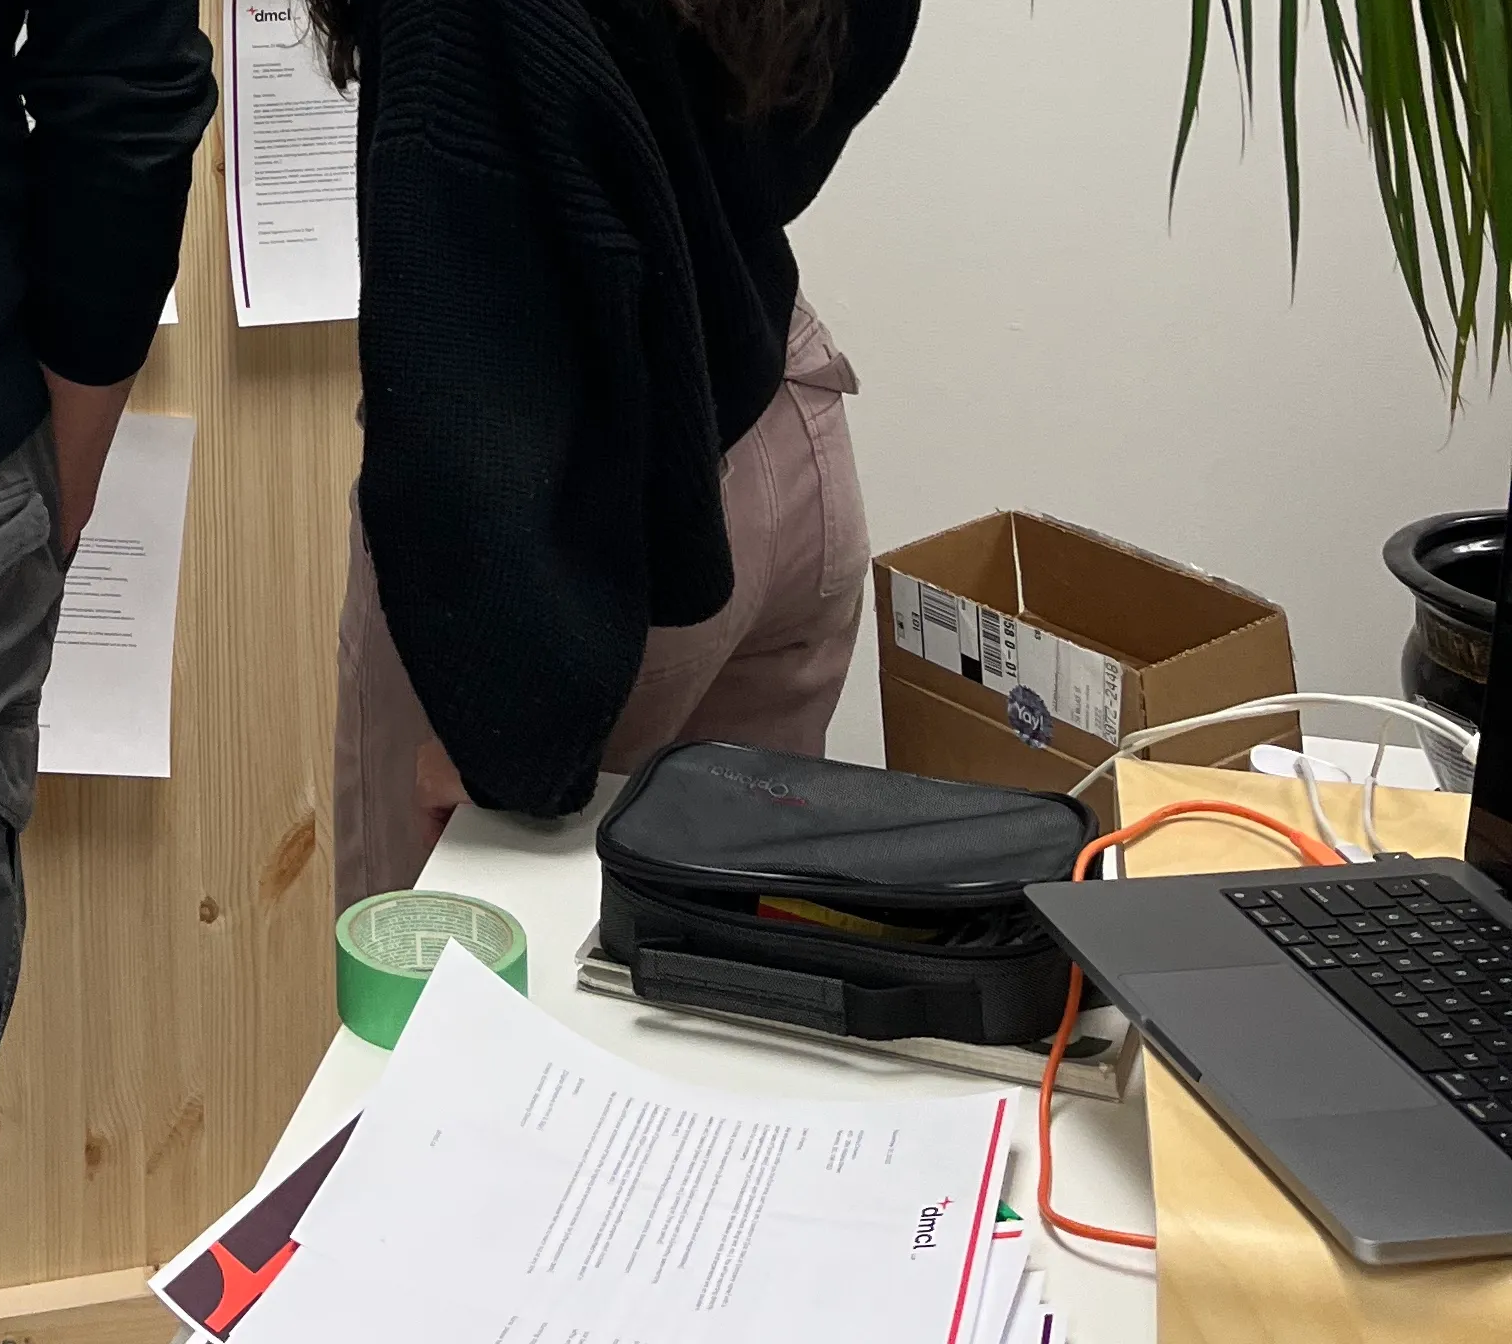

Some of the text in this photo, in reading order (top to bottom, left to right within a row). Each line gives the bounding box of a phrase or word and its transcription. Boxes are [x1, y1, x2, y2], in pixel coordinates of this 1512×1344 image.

[254, 7, 290, 22] dmcl
[1016, 703, 1045, 731] Yay!
[913, 1206, 944, 1250] dmcl
